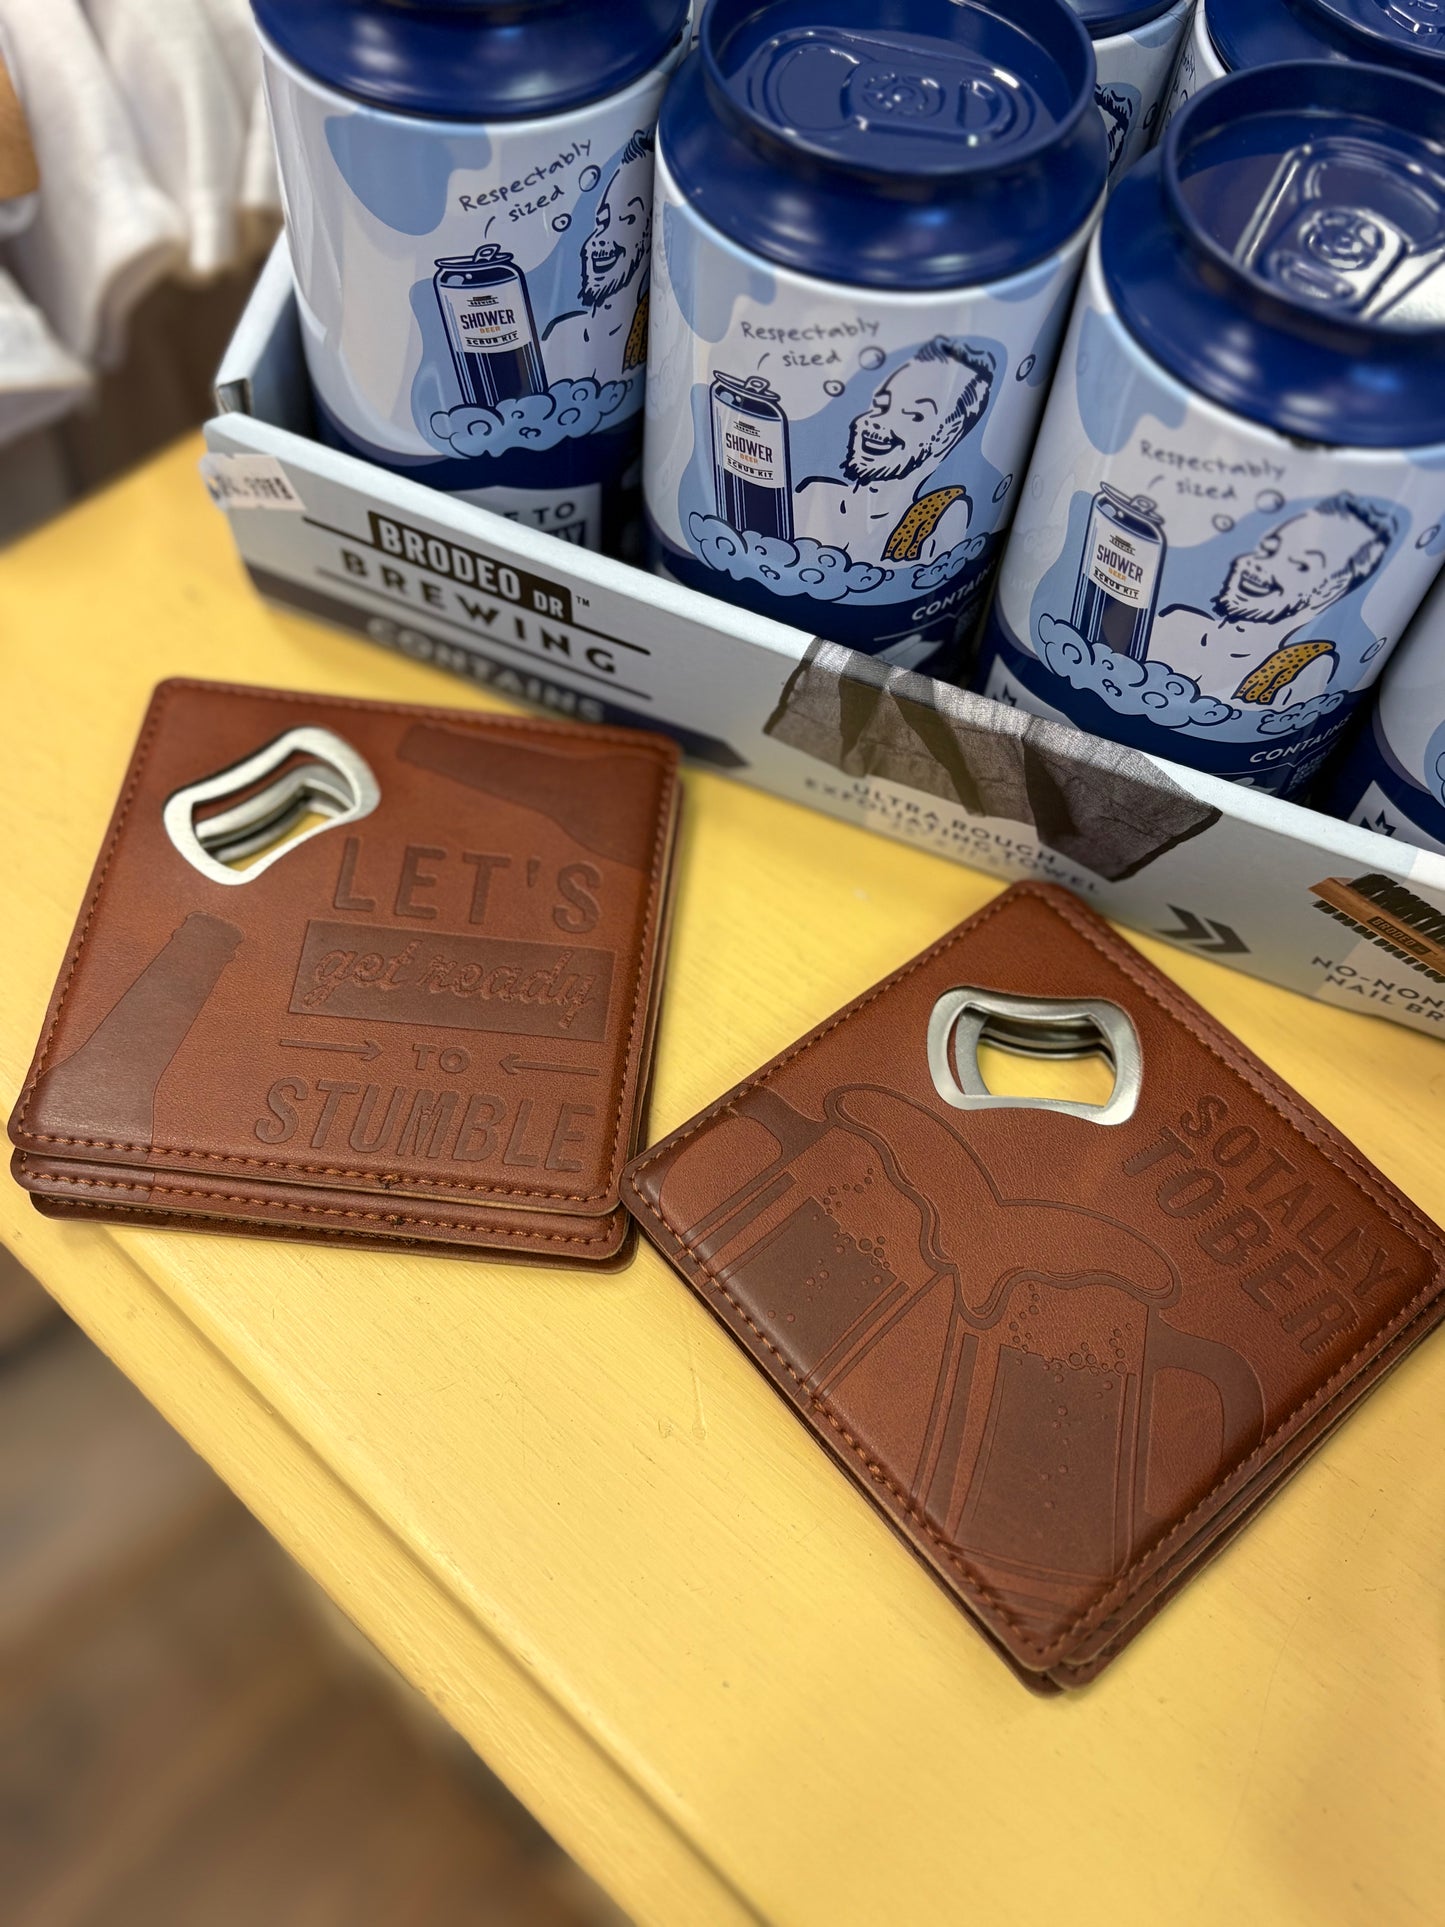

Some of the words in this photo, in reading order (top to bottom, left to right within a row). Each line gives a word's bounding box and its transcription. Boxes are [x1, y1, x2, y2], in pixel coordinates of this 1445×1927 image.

[458, 139, 592, 212] Respectably
[508, 185, 565, 222] sized
[460, 309, 516, 330] SHOWER
[741, 318, 880, 343] Respectably
[783, 350, 842, 367] sized
[726, 432, 773, 464] SHOWER
[1140, 440, 1289, 481] Respectably
[1175, 476, 1240, 500] sized
[531, 501, 576, 525] TO
[377, 519, 521, 600] BRODEO
[533, 590, 565, 619] DR
[1097, 544, 1144, 584] SHOWER
[340, 549, 617, 674] BREWING
[852, 782, 940, 824] ULTRA
[951, 819, 1056, 866] ROUGH
[333, 837, 602, 933] LET'S
[303, 938, 424, 1009] get
[420, 950, 597, 1030] ready
[1312, 956, 1445, 1009] NO-NON
[1325, 975, 1396, 1005] NAIL
[412, 1043, 472, 1074] TO
[255, 1076, 597, 1173] STUMBLE
[1180, 1094, 1406, 1298] SOTALLY
[1122, 1126, 1360, 1357] TOBER
